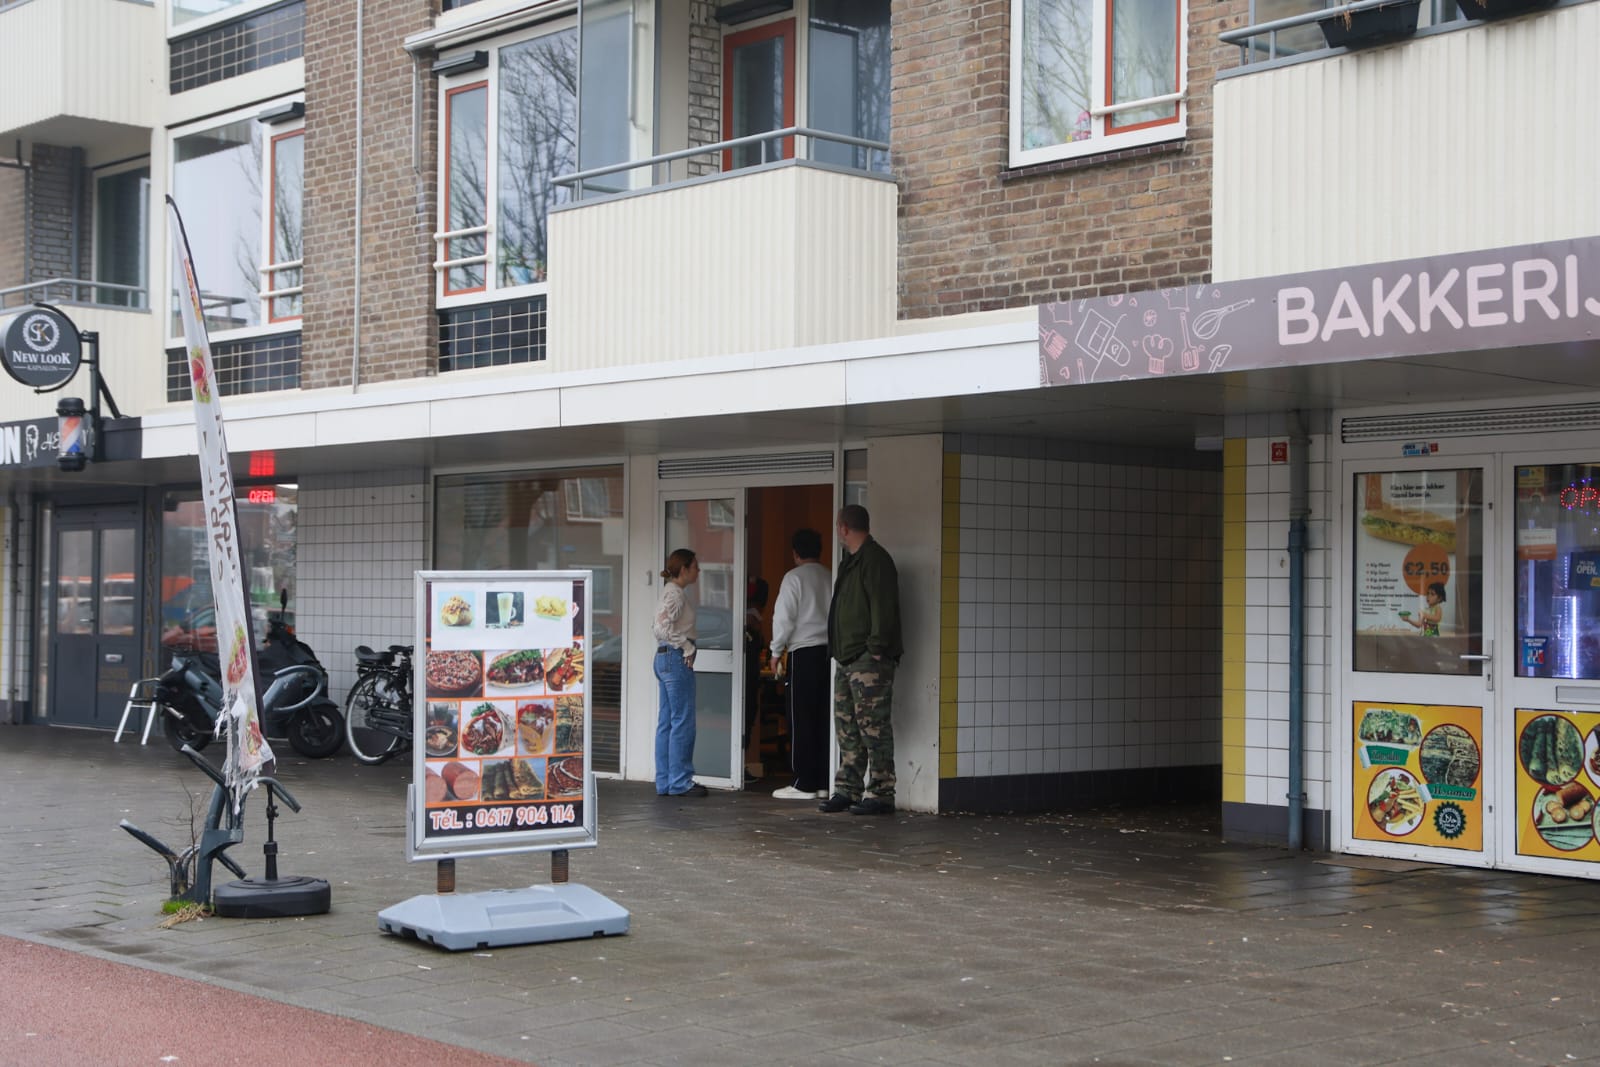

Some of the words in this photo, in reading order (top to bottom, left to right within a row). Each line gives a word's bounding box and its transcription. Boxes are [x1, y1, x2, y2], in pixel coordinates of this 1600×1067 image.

[12, 350, 39, 363] NEW
[40, 352, 71, 365] LOOK
[0, 425, 21, 465] N
[249, 488, 275, 504] OPEN
[1560, 487, 1600, 508] OP
[1404, 561, 1450, 578] €2,50
[475, 806, 513, 827] 0617
[516, 806, 548, 825] 904
[550, 804, 576, 823] 114
